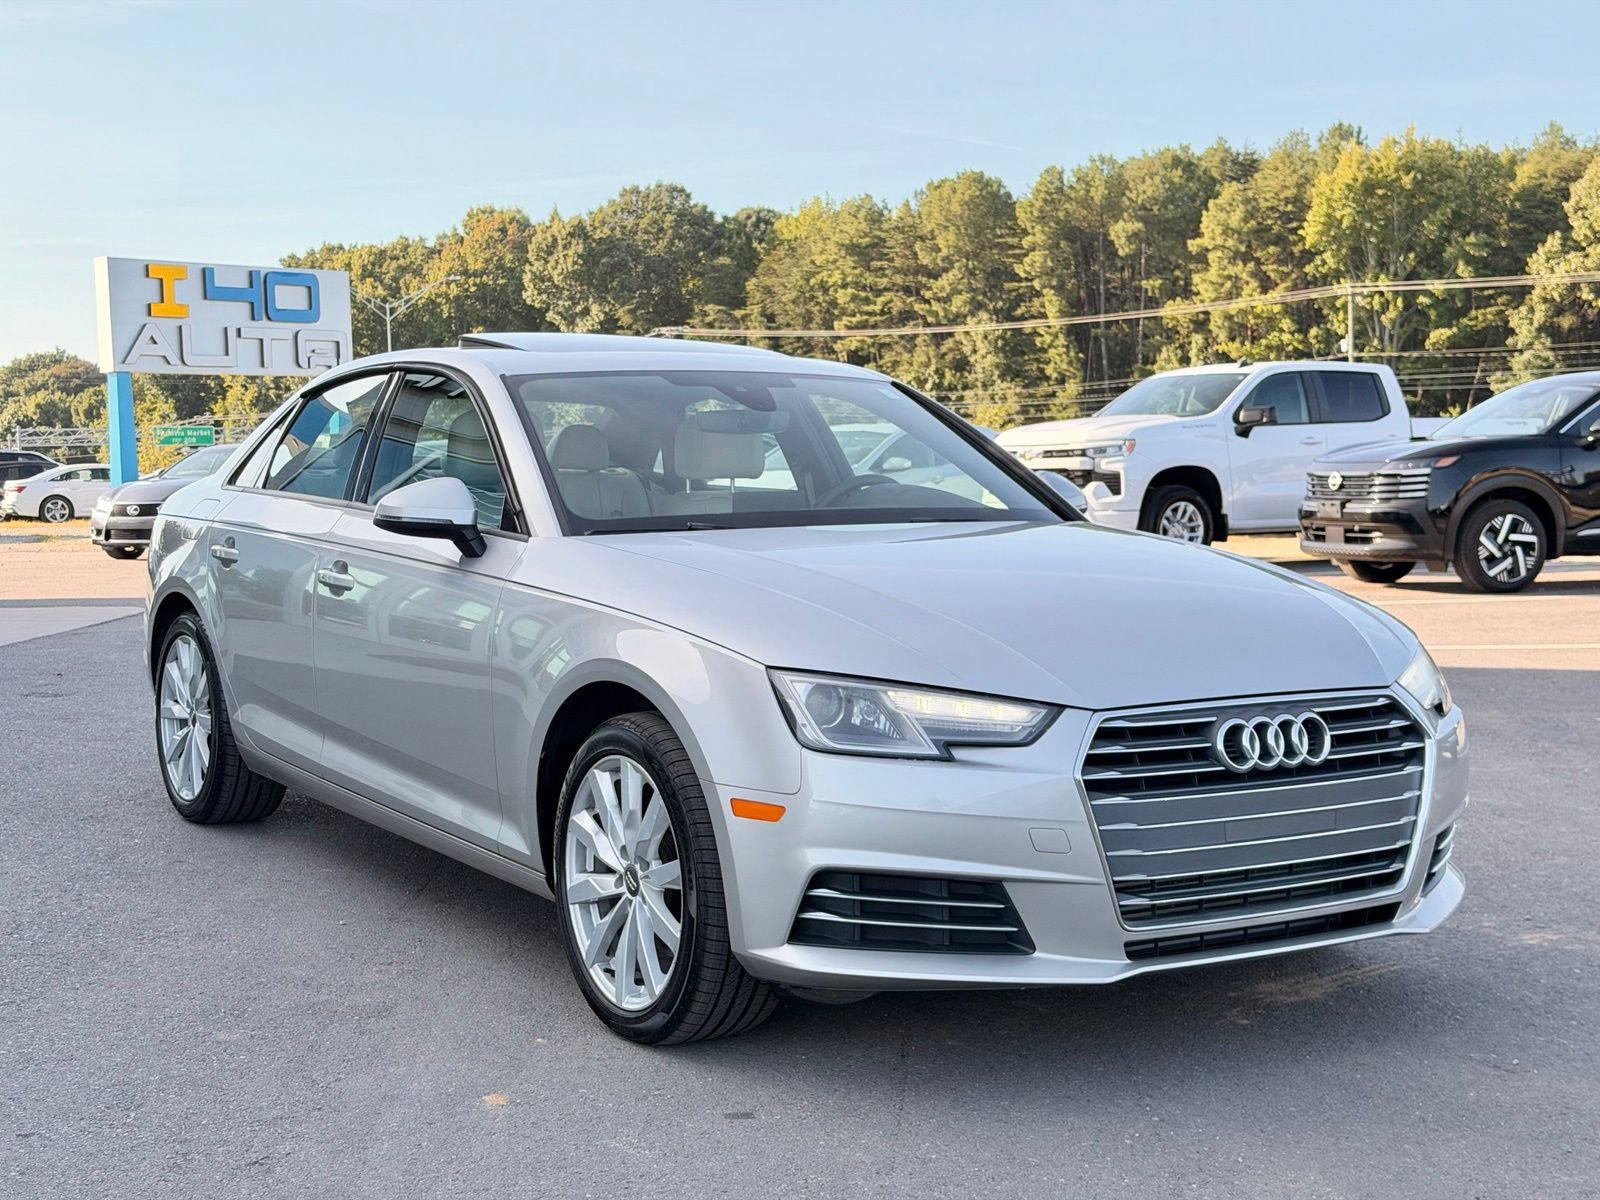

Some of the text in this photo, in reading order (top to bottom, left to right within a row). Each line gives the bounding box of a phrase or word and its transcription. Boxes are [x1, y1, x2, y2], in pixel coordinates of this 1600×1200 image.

[147, 263, 321, 323] I 40
[122, 322, 348, 370] AUTO
[186, 429, 211, 437] Market
